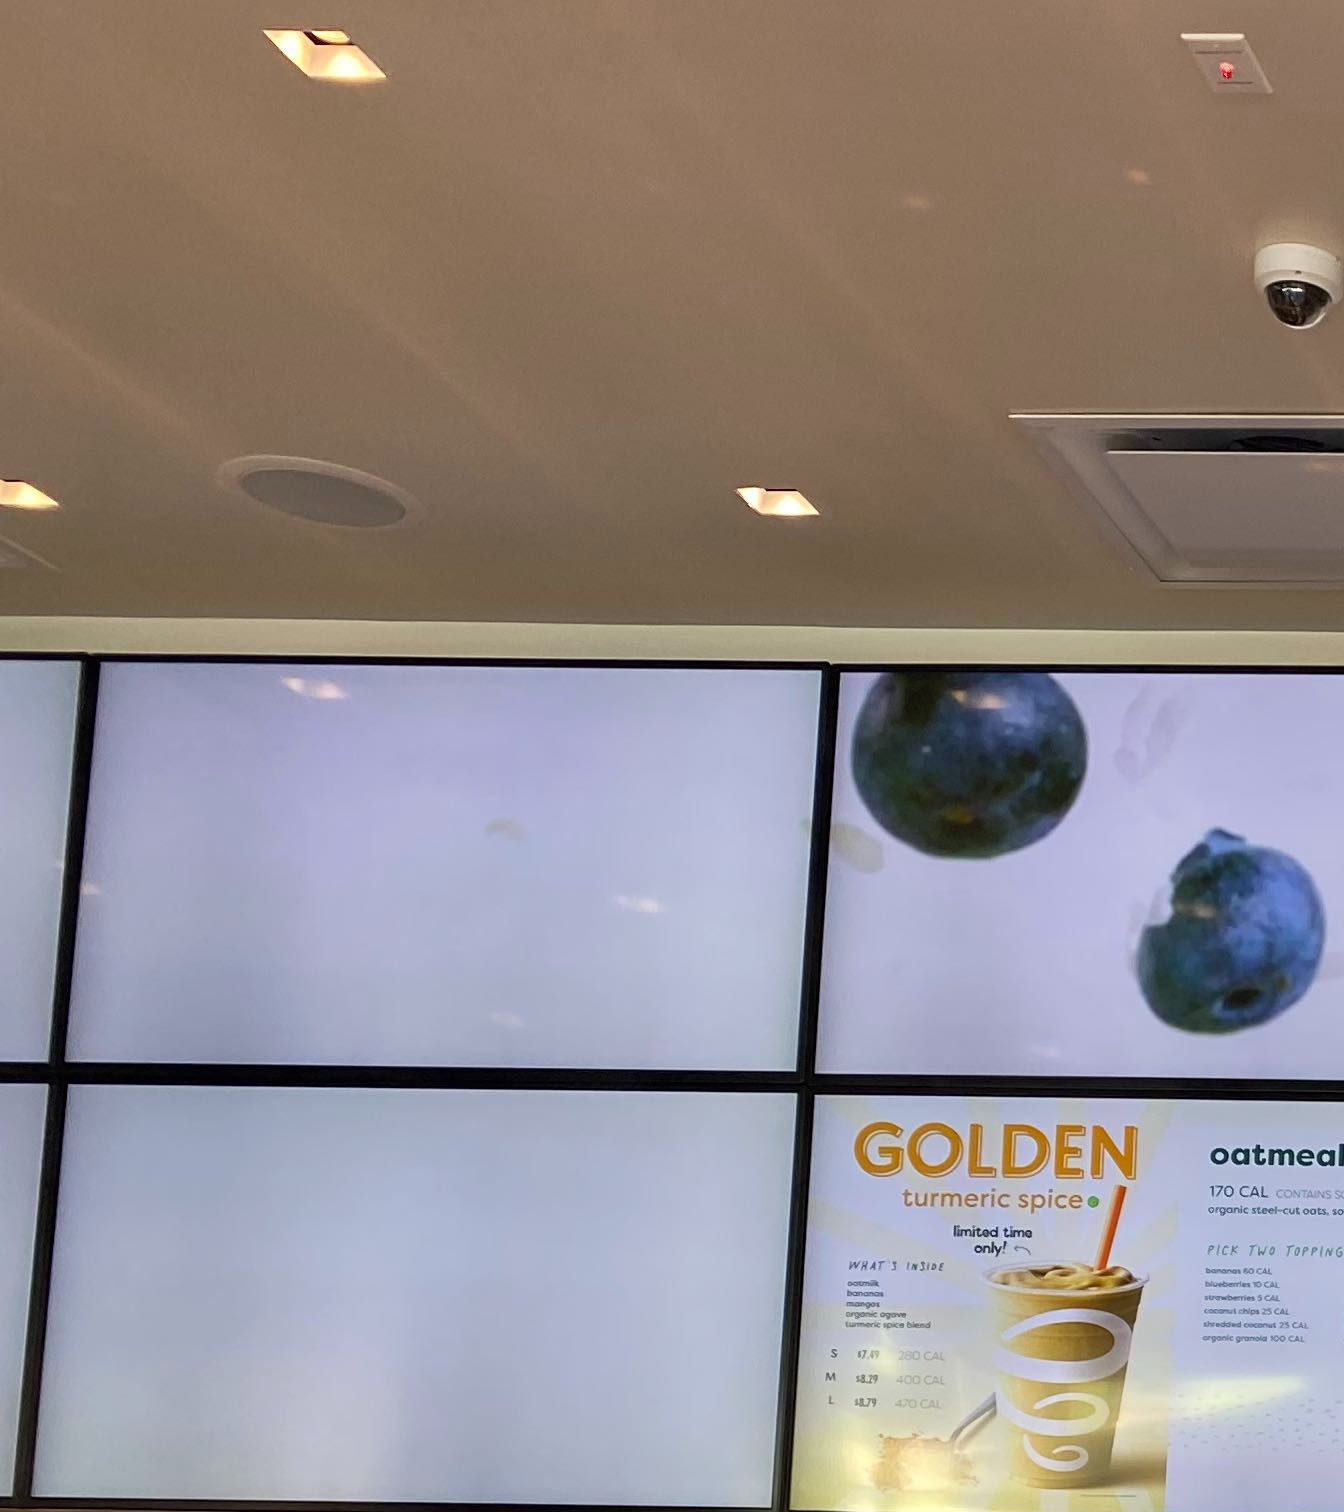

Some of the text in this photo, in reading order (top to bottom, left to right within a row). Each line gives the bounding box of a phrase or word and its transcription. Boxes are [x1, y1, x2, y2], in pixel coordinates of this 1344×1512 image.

[853, 1121, 1139, 1180] GOLDEN
[1209, 1143, 1344, 1167] oatmeal
[1209, 1184, 1235, 1199] 170
[1239, 1185, 1268, 1199] CAL
[1275, 1188, 1332, 1200] CONTAINS
[902, 1188, 1083, 1213] turmeric spice
[1207, 1205, 1249, 1217] organic
[1251, 1206, 1300, 1216] steel-cut
[953, 1225, 1033, 1239] limited time
[973, 1241, 1007, 1257] only!
[1207, 1244, 1239, 1257] PICK
[1248, 1244, 1276, 1257] TWO
[906, 1262, 945, 1272] INSIDE
[846, 1289, 884, 1298] bananas
[830, 1349, 838, 1359] S
[825, 1372, 878, 1384] M $8.29
[828, 1395, 877, 1408] L $8.79
